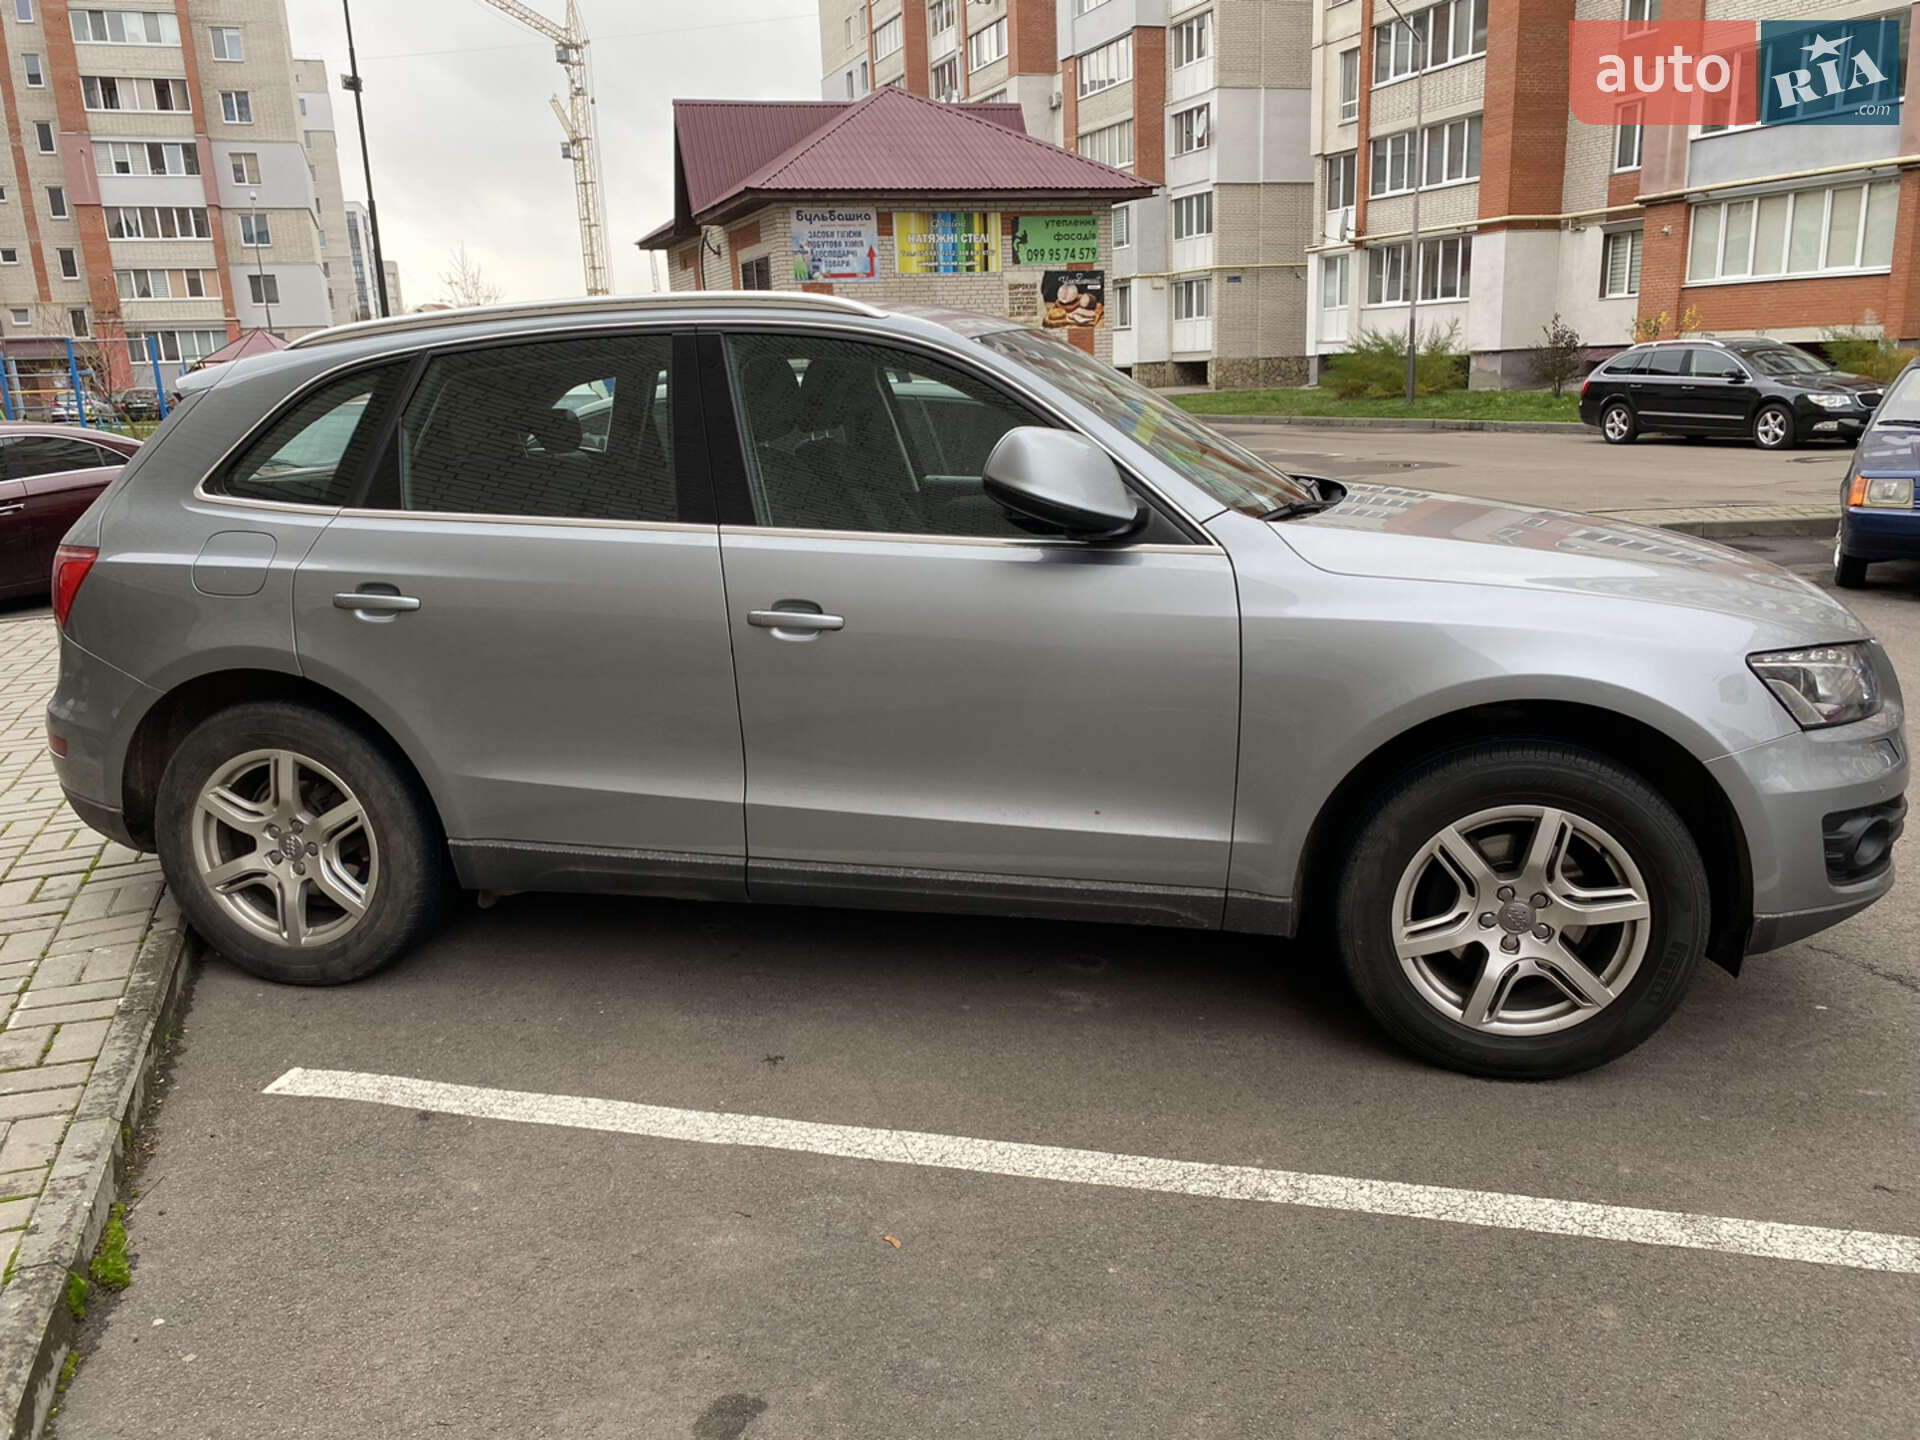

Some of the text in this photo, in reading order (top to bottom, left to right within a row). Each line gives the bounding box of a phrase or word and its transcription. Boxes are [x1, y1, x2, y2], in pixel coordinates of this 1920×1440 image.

[907, 232, 990, 244] НАТЯЖНІ СТЕЛІ
[1026, 247, 1097, 261] 099 95 74 579
